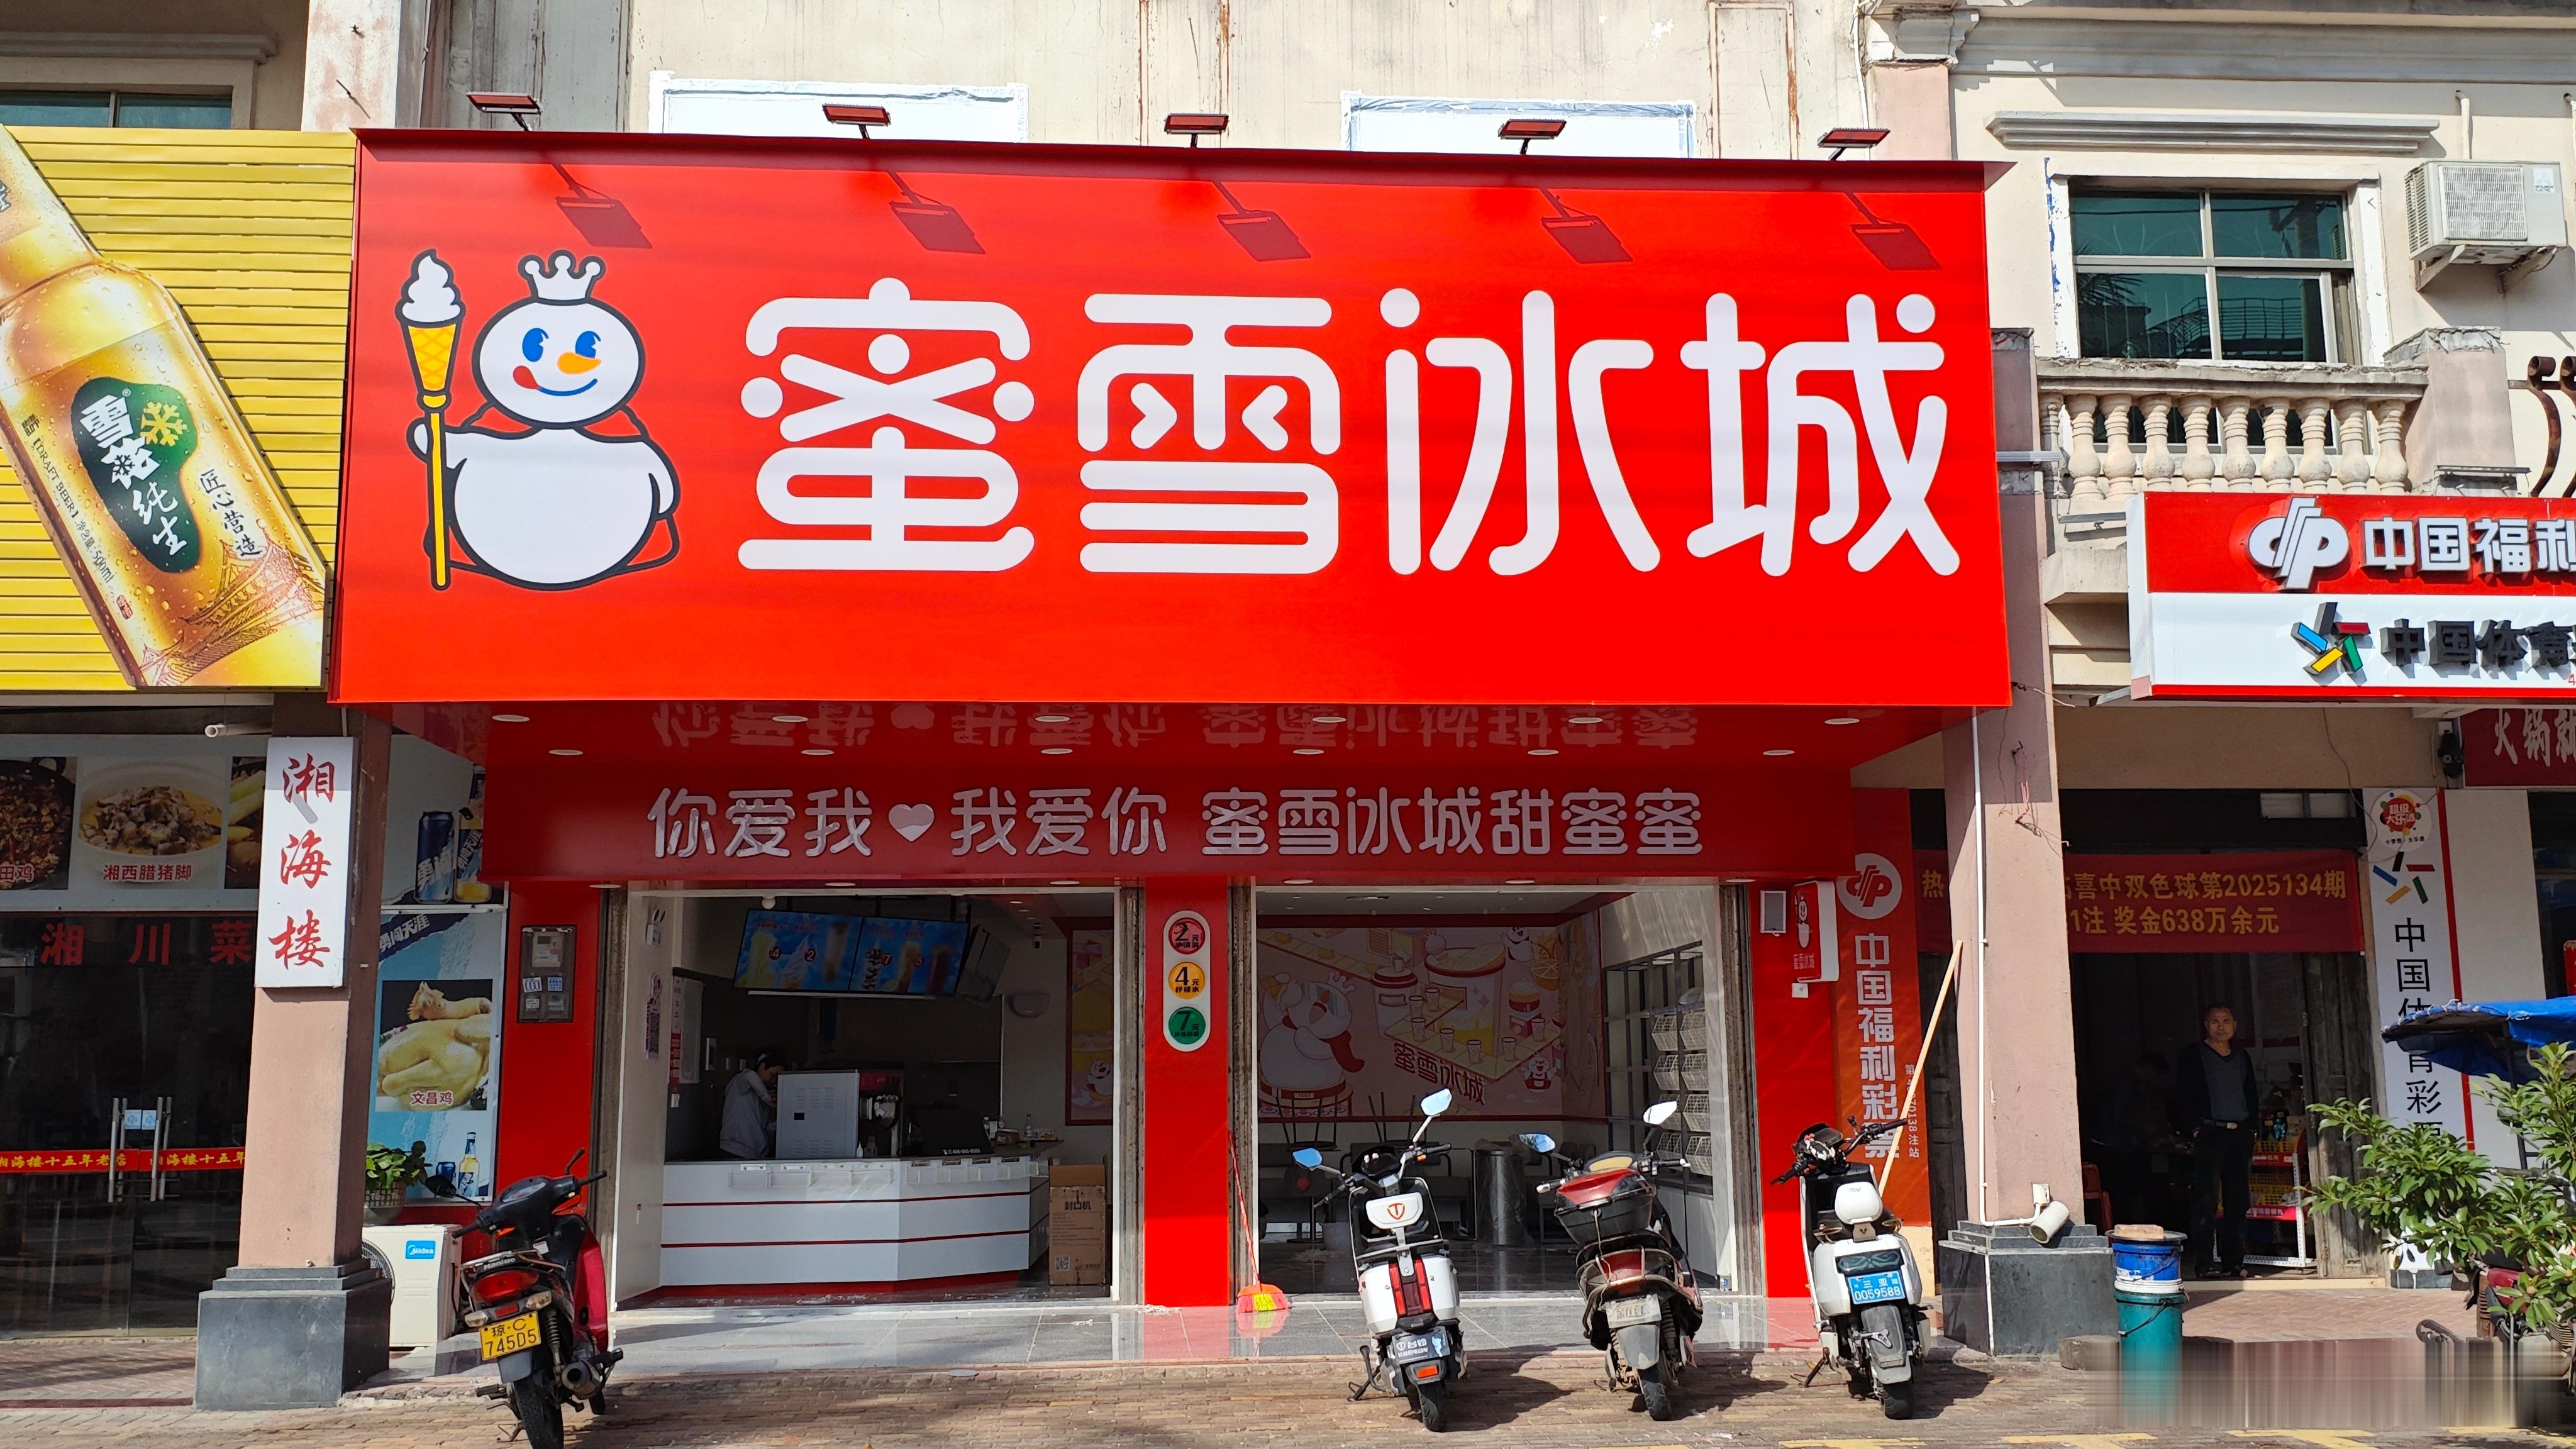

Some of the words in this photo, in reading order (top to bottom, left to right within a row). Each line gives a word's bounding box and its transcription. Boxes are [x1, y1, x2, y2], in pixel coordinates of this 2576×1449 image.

[738, 277, 1960, 576] 蜜雪冰城
[199, 469, 263, 557] 匠心营造
[2380, 618, 2576, 667] 中国体育
[1201, 786, 1703, 856] 蜜雪冰城甜蜜蜜
[103, 863, 192, 881] 湘西腊猪脚
[267, 753, 335, 970] 湘海楼
[2114, 906, 2280, 935] 奖金638万余元
[1394, 1041, 1487, 1106] 蜜雪冰城
[409, 1090, 453, 1106] 文昌鸡
[409, 1245, 435, 1255] Midea
[1854, 1285, 1902, 1301] 0059588
[484, 1328, 538, 1357] 745D5
